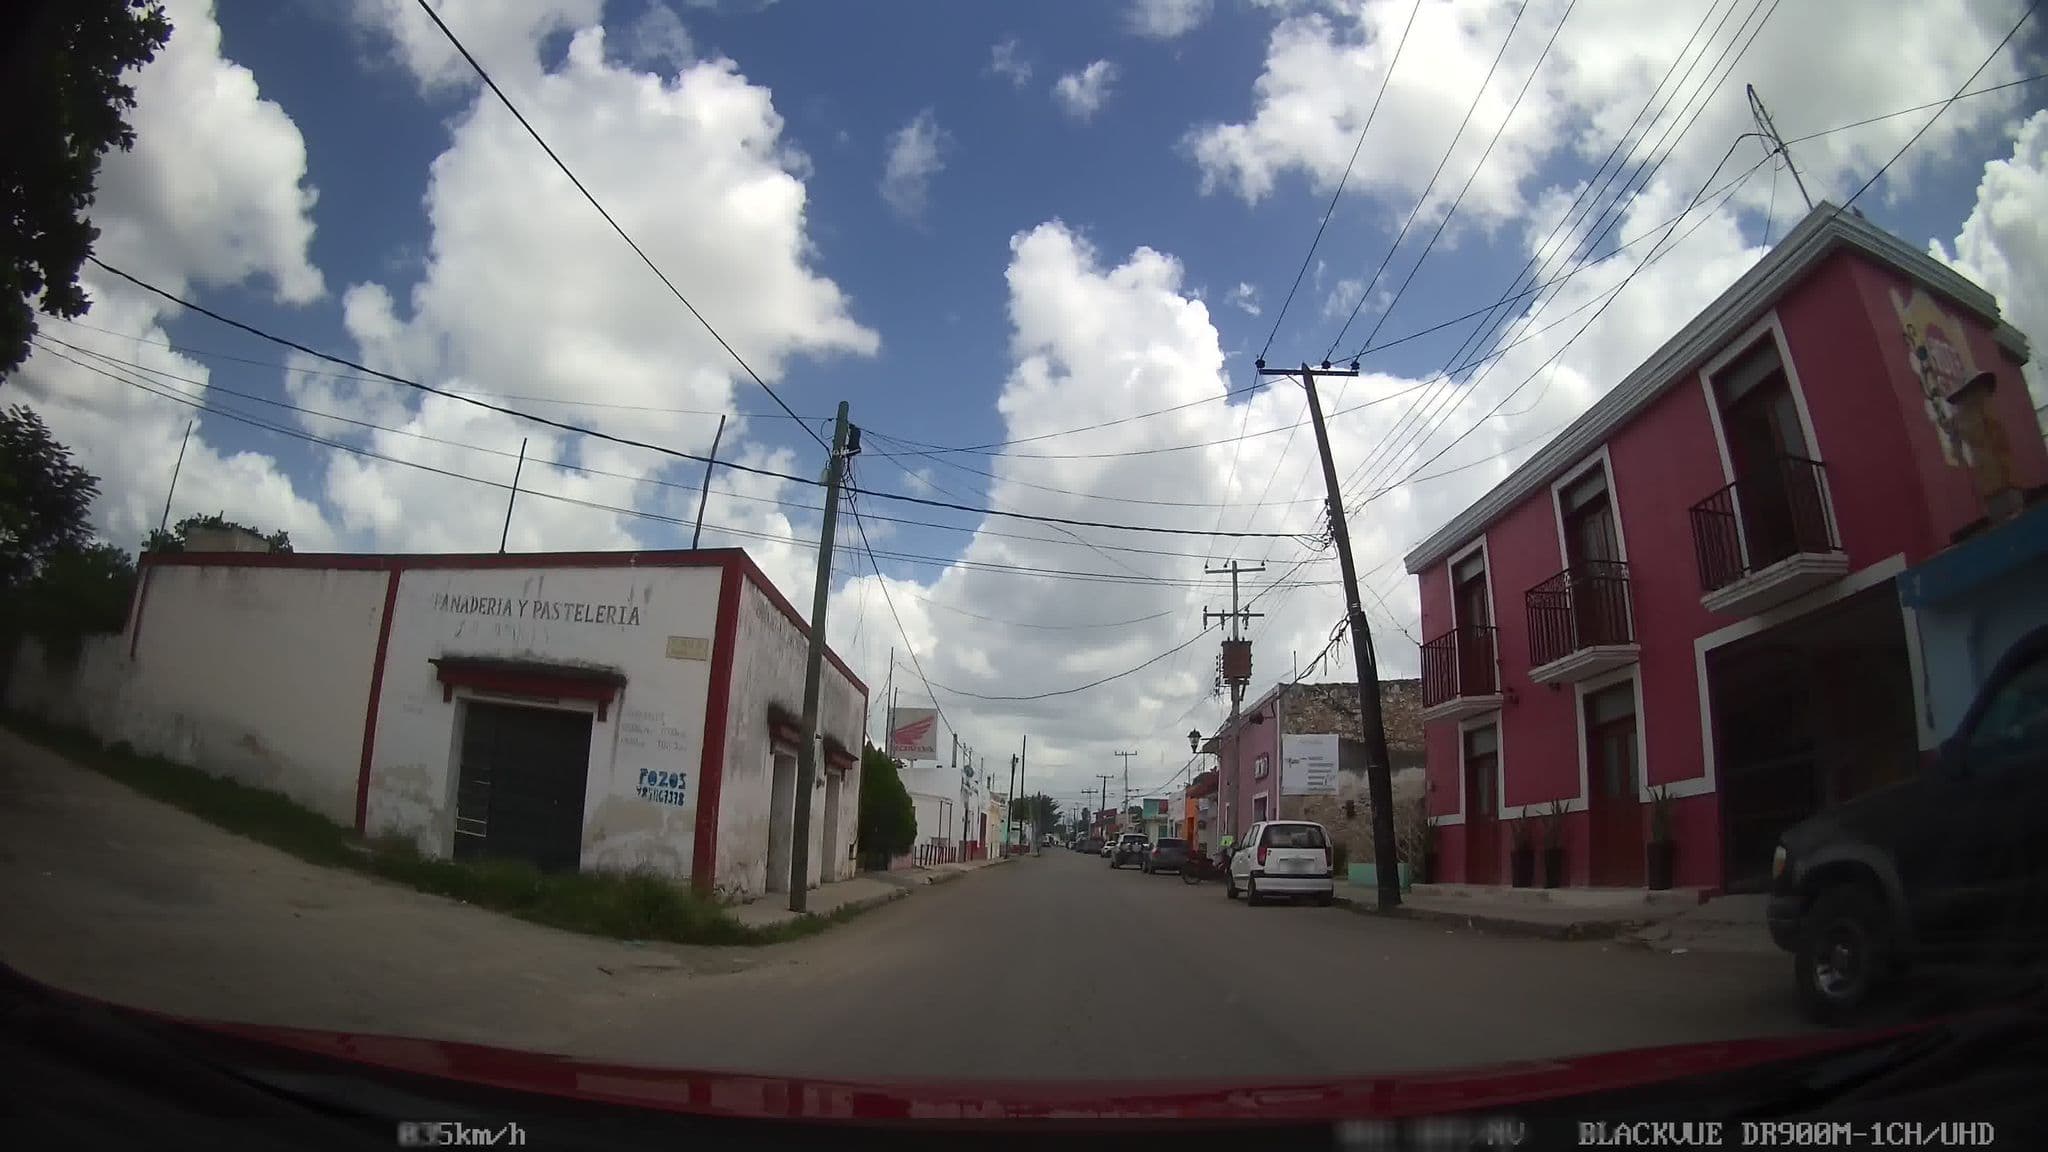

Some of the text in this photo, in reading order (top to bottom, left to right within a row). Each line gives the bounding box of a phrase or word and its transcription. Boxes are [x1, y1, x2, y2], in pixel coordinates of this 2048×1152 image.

[518, 599, 529, 620] Y
[532, 600, 641, 626] PASTELERIA
[639, 768, 687, 790] POZOS
